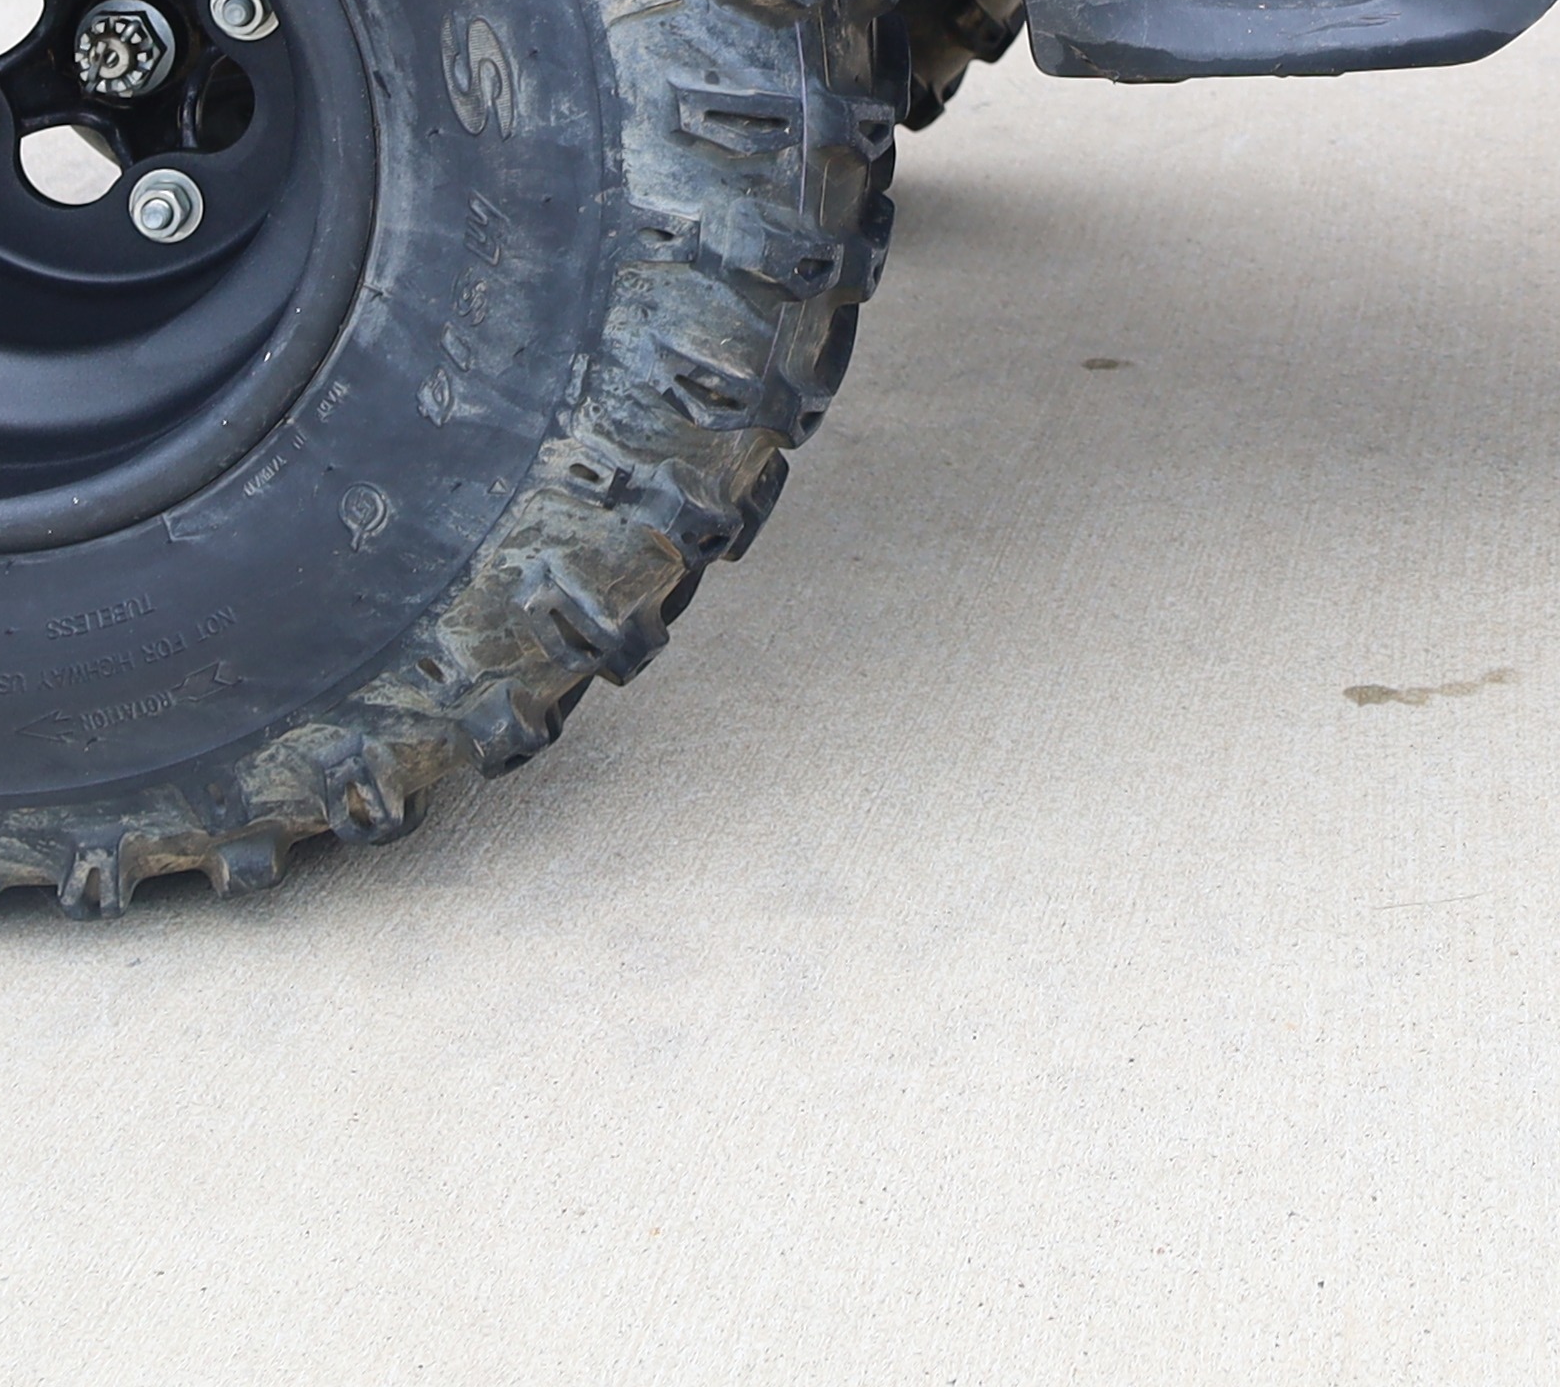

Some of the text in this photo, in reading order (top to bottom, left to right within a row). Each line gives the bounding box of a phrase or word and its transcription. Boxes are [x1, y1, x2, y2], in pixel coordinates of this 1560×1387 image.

[43, 590, 158, 641] TUBELESS
[189, 602, 238, 644] NOT
[139, 629, 189, 666] FOR
[35, 648, 136, 691] HIGHWAY
[78, 687, 178, 732] ROTATION
